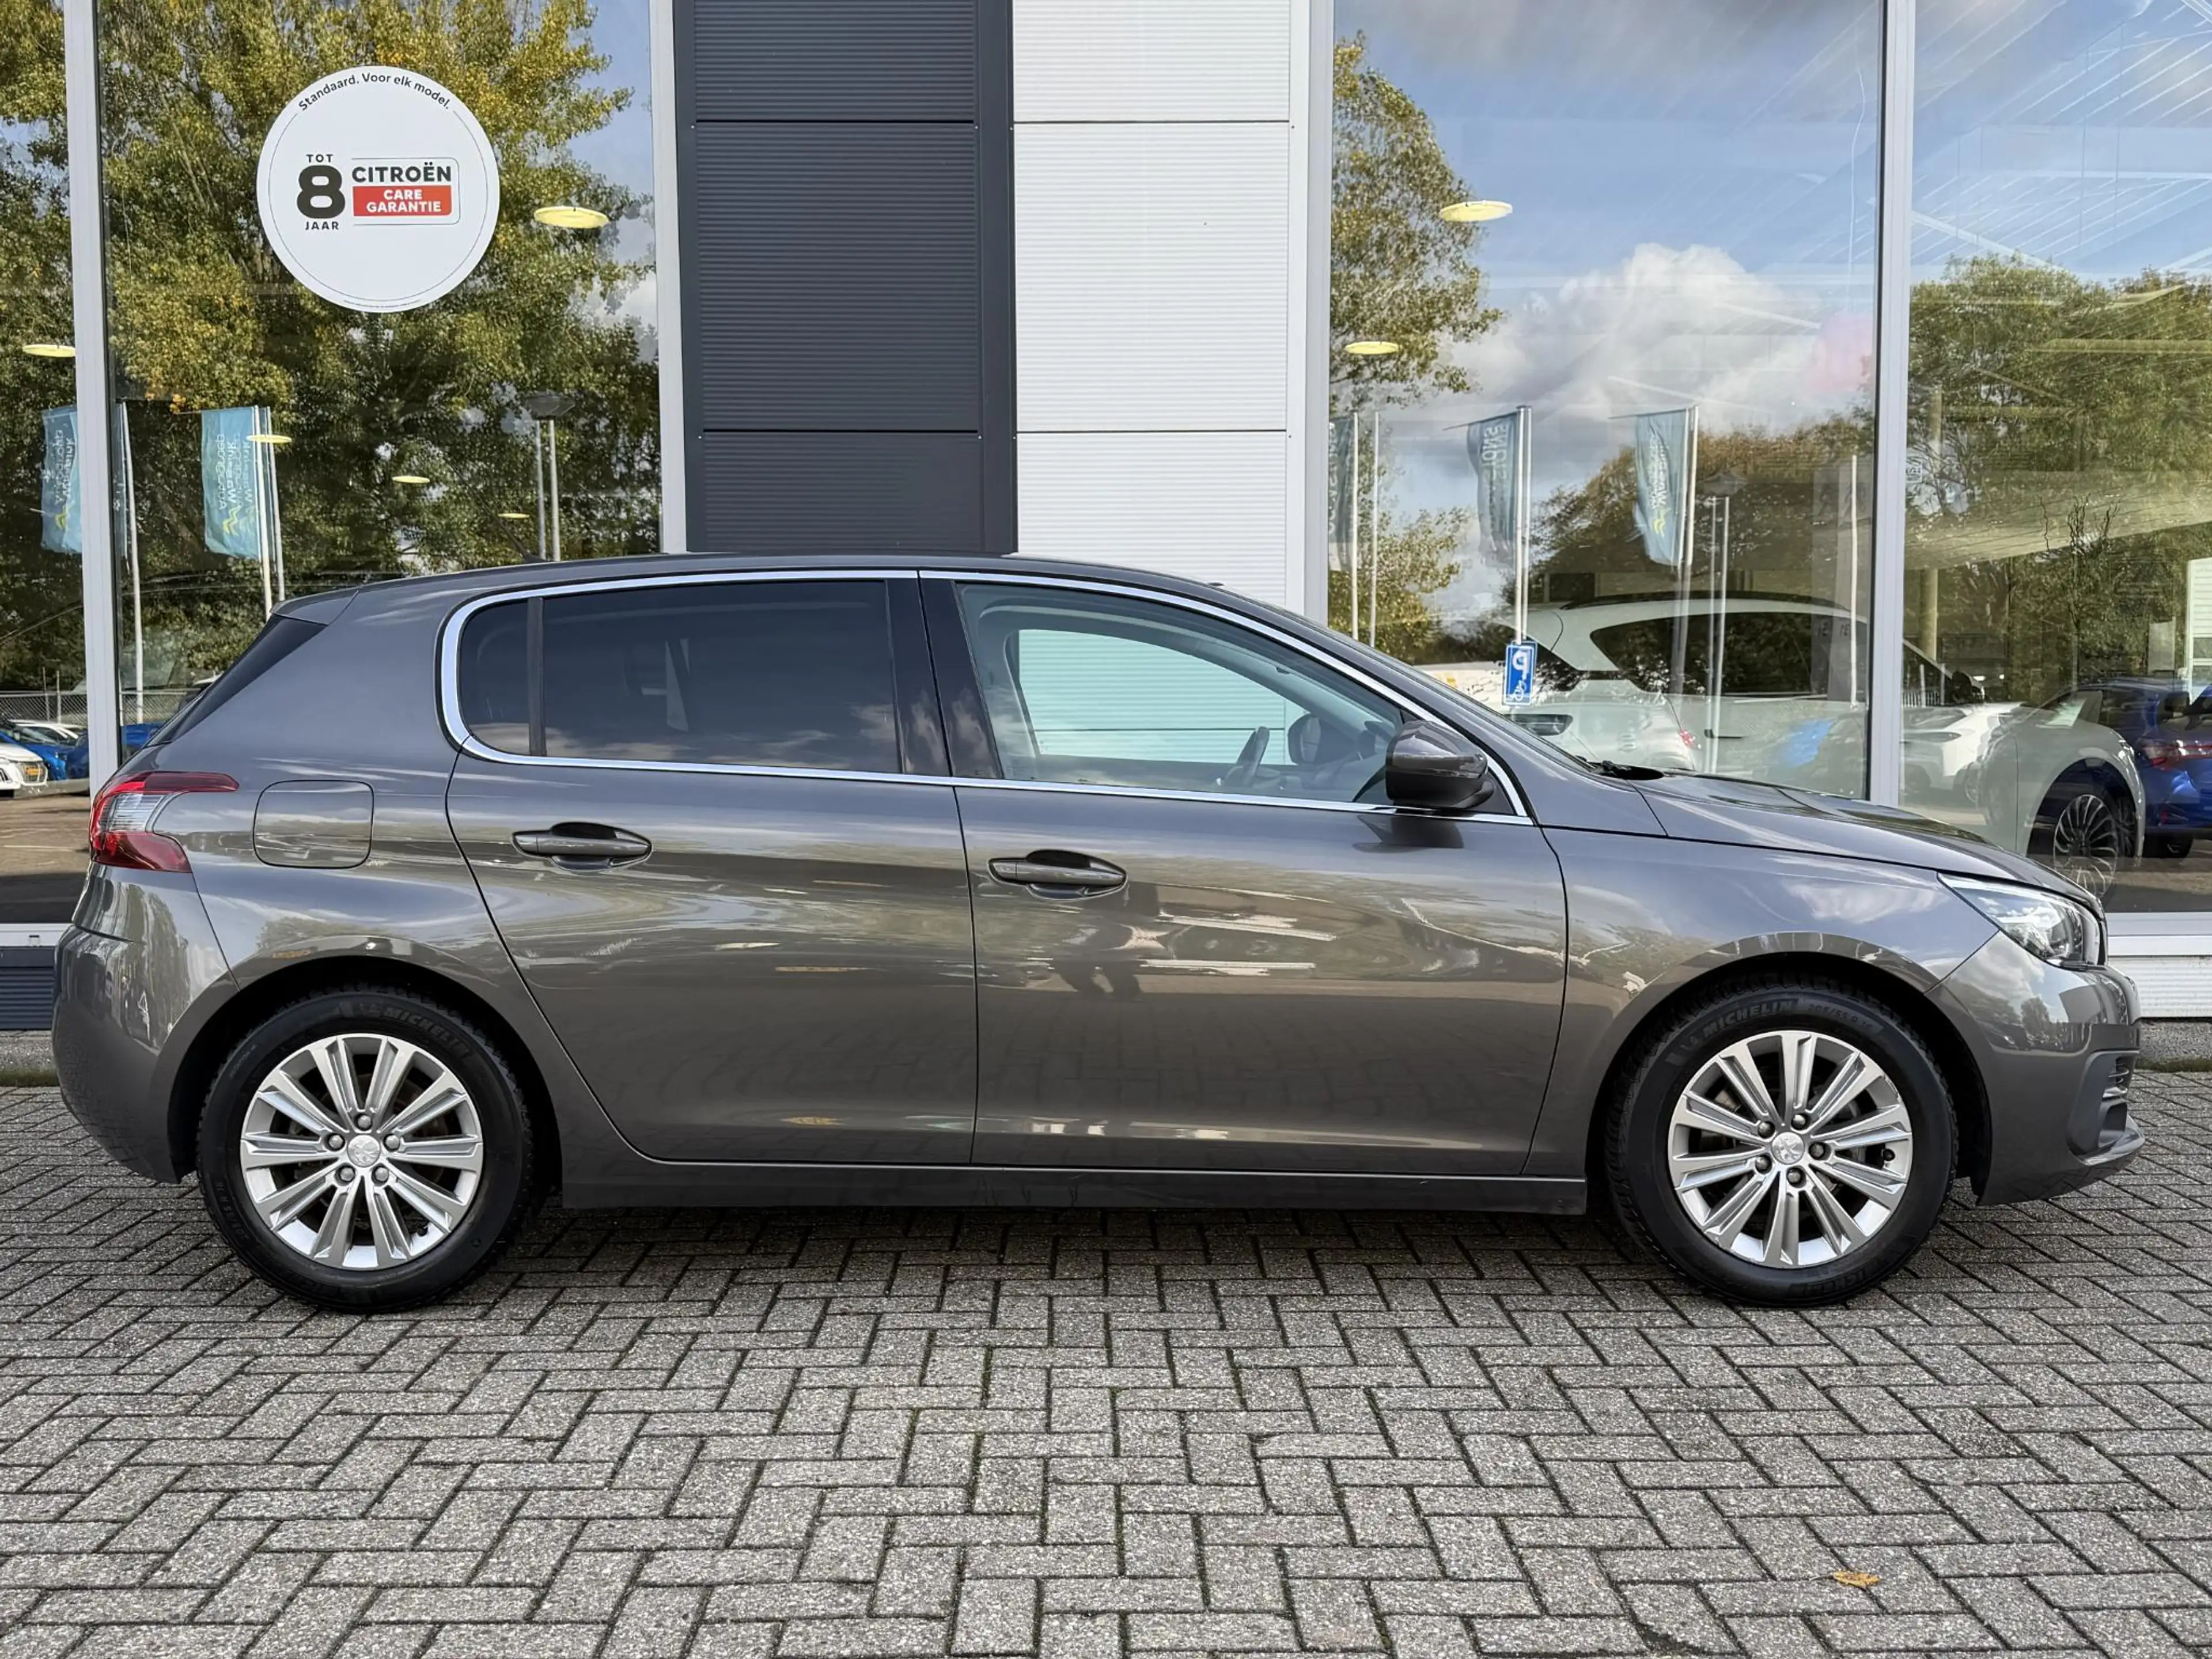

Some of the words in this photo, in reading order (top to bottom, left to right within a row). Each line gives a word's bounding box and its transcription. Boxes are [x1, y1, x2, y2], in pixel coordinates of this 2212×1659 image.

[298, 74, 359, 111] Standaard.
[362, 73, 391, 83] Voor
[393, 75, 412, 89] elk
[414, 82, 450, 109] model.
[306, 154, 334, 163] TOT
[351, 162, 451, 183] CITROËN
[297, 165, 346, 219] 8
[383, 189, 422, 200] CARE
[366, 201, 442, 213] GARANTIE
[305, 221, 339, 230] JAAR
[1703, 999, 1796, 1036] MICHELIN
[384, 1007, 471, 1056] MICHELIN
